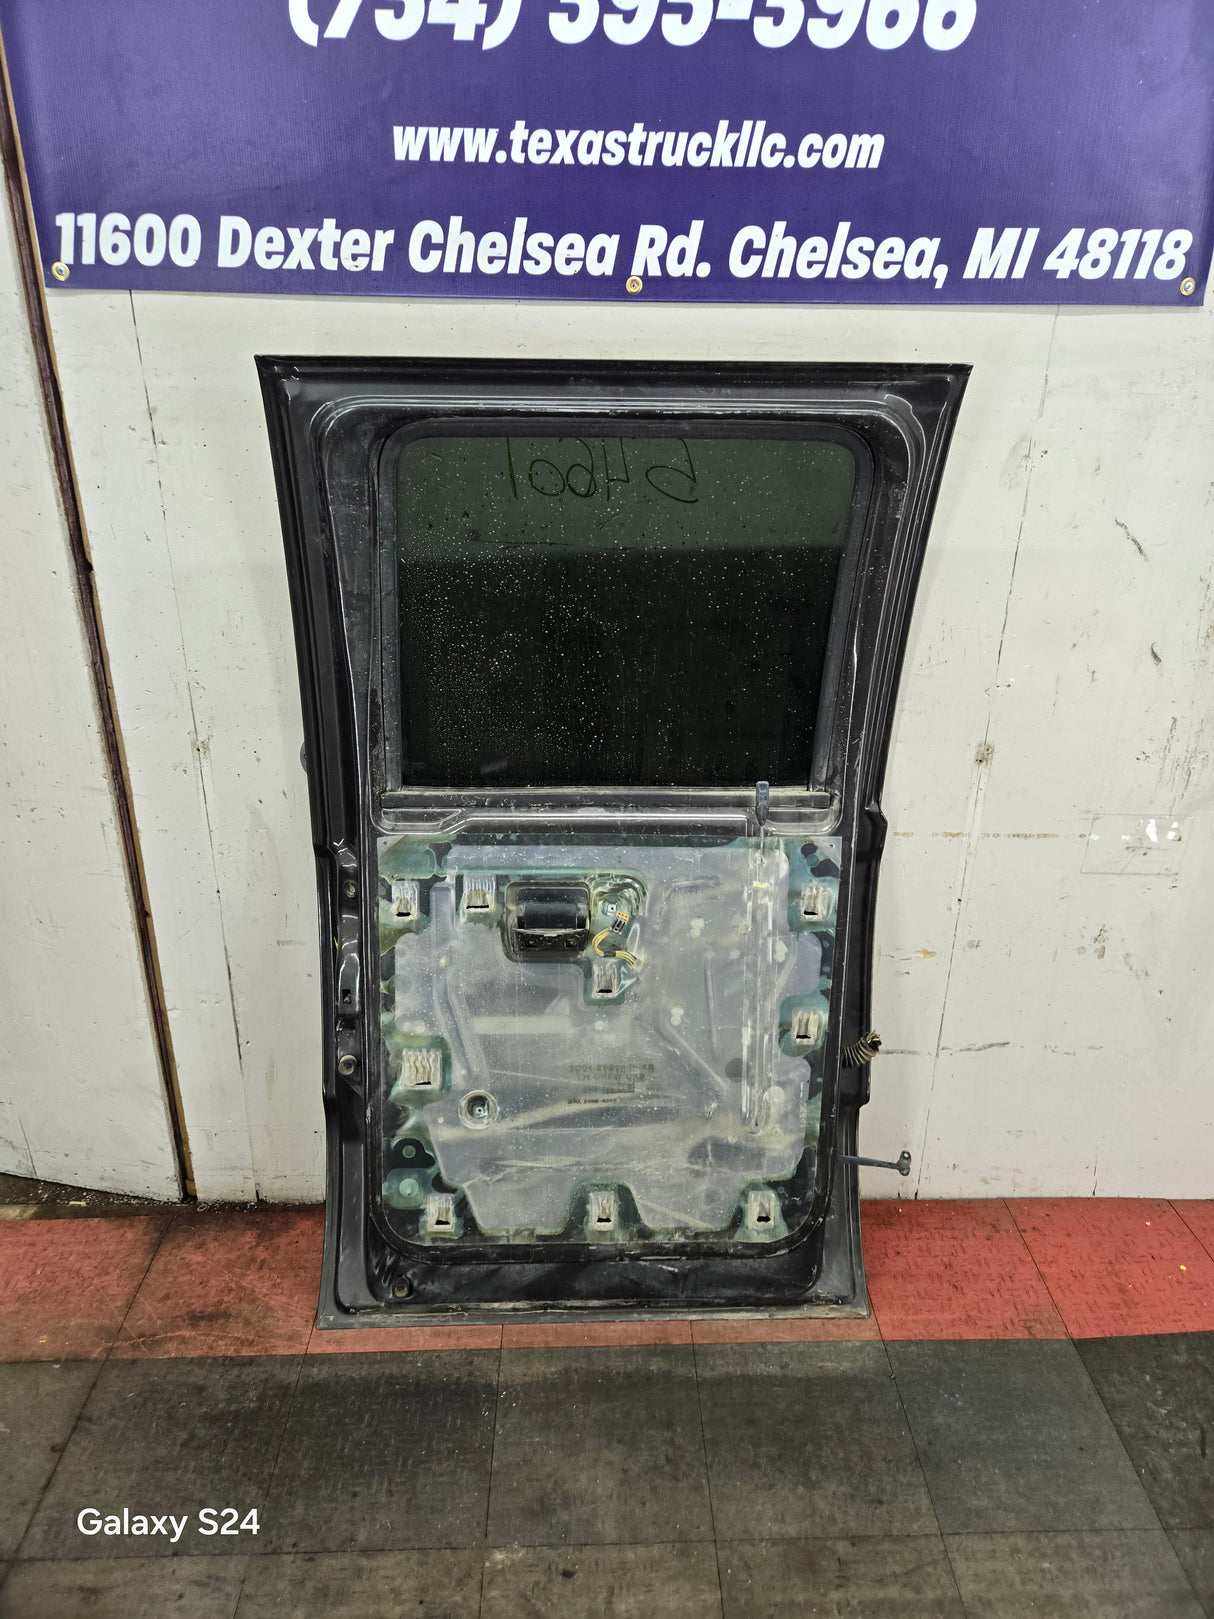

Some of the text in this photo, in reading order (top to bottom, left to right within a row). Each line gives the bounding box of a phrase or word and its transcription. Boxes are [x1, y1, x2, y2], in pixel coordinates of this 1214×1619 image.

[392, 120, 885, 169] www.texastruckllc.com
[55, 212, 1194, 289] 11600 Dexter Chelsea Rd. Chelsea, MI 48118
